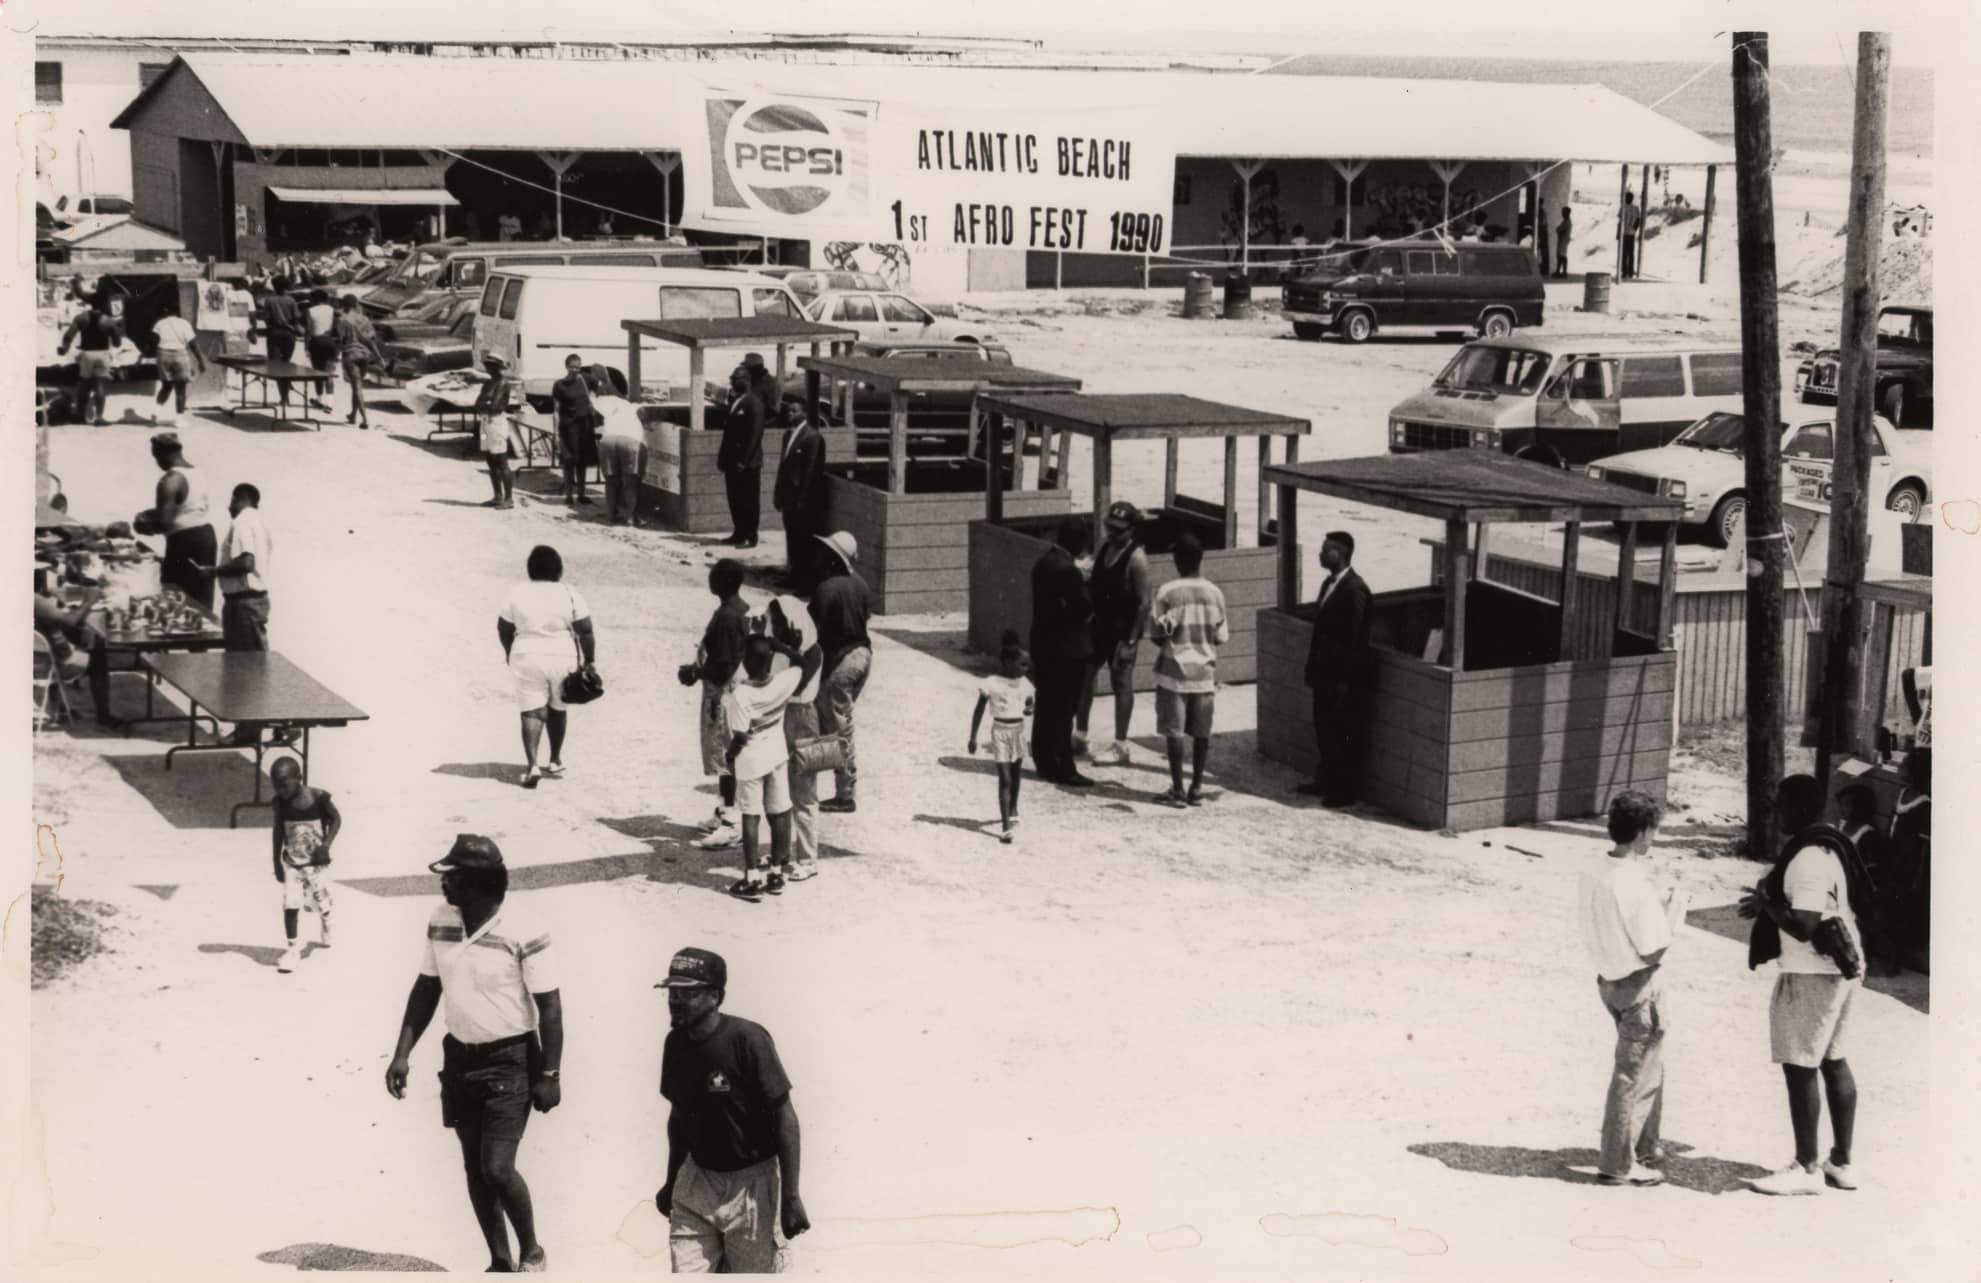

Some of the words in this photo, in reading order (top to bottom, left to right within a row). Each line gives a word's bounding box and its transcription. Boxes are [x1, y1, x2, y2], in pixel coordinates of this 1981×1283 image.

[734, 141, 843, 177] PEPSI
[918, 129, 1038, 173] ATLANTIC
[1057, 136, 1131, 180] BEACH
[953, 203, 1014, 247] AFRO
[1029, 206, 1088, 250] FEST
[1109, 211, 1164, 254] 1990
